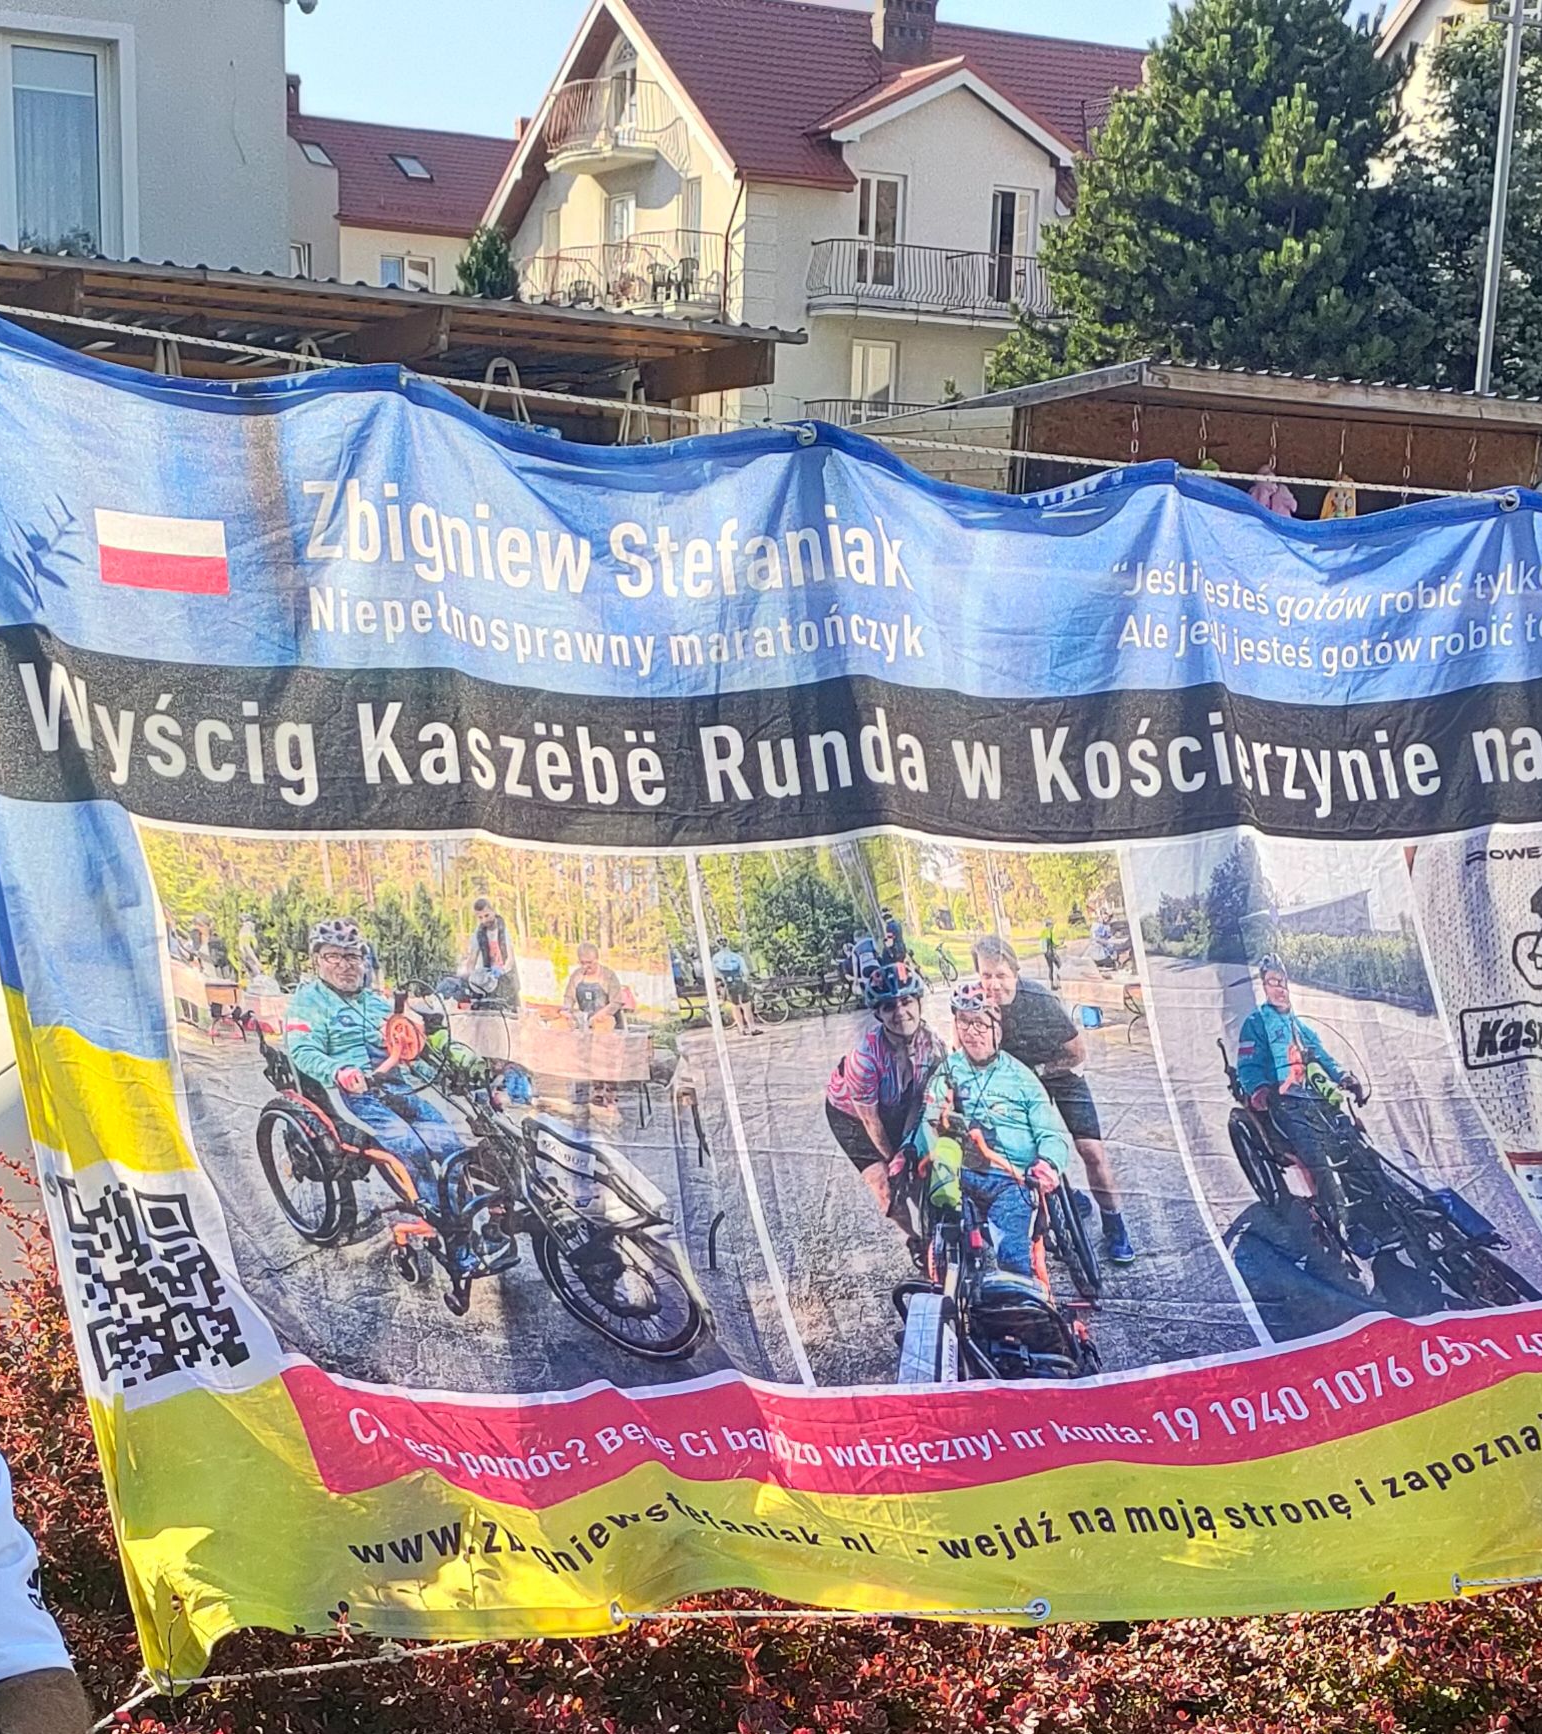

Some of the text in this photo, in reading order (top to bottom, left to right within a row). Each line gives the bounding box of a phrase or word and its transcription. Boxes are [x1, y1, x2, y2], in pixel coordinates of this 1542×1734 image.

[303, 478, 915, 598] Zbigniew Stefaniak
[309, 586, 925, 678] Niepełnosprawny maratończyk
[1116, 614, 1168, 650] Ale
[1232, 628, 1313, 668] jesteś
[1321, 632, 1423, 678] gotów
[1430, 612, 1513, 660] robić
[1276, 587, 1371, 627] gotów
[1380, 571, 1463, 617] robić
[18, 661, 320, 806] Wyścig
[357, 701, 668, 807] Kaszëbë
[698, 706, 929, 802] Runda
[952, 739, 1004, 801] w
[1030, 710, 1441, 819] Kościerzynie
[461, 1438, 588, 1481] pomóc?
[679, 1428, 716, 1458] Ci
[726, 1425, 822, 1467] bardzo
[829, 1427, 1006, 1472] wdzięczny!
[1010, 1425, 1045, 1450] nr
[1051, 1419, 1154, 1447] konta:
[1152, 1407, 1200, 1443] 19
[1210, 1386, 1309, 1436] 1940
[1313, 1355, 1415, 1411] 1076
[939, 1512, 1062, 1561] wejdź
[1067, 1510, 1116, 1536] na
[1124, 1498, 1217, 1541] moją
[1228, 1493, 1352, 1530] stronę
[1355, 1479, 1376, 1505] i
